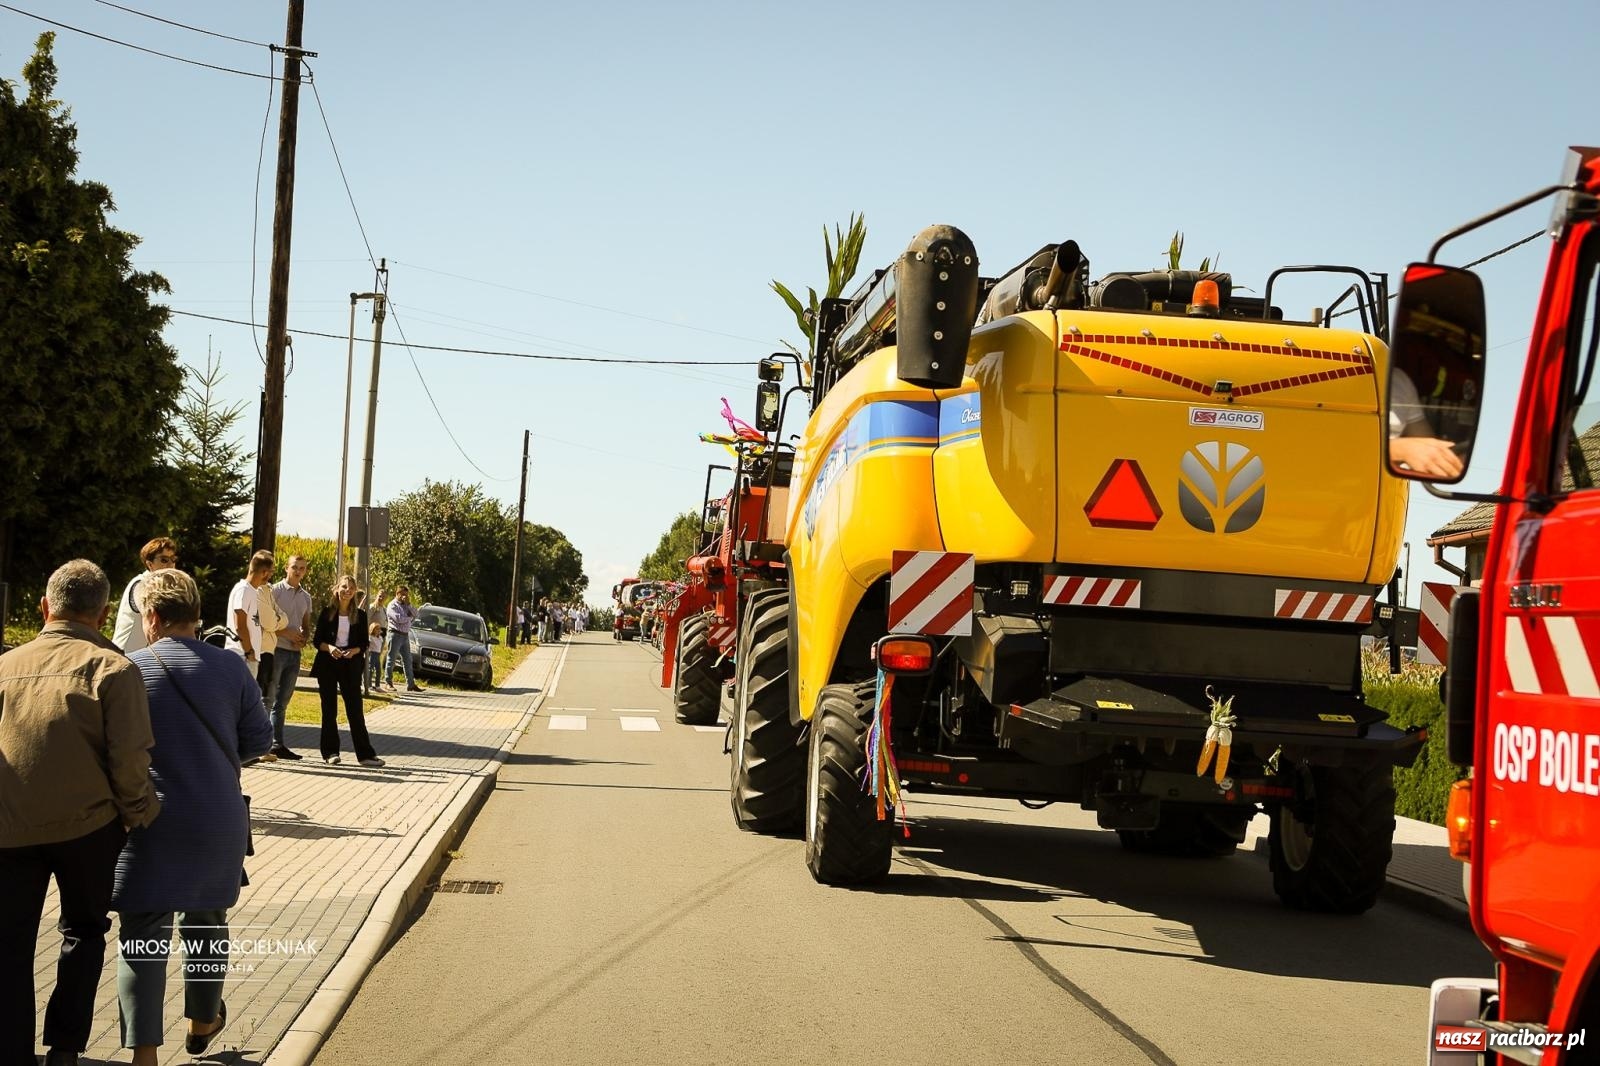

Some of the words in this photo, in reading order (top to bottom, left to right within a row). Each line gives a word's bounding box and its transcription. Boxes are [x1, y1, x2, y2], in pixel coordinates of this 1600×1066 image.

[1218, 412, 1259, 423] AGROS
[1493, 723, 1536, 784] OSP
[1538, 728, 1600, 796] BOLE
